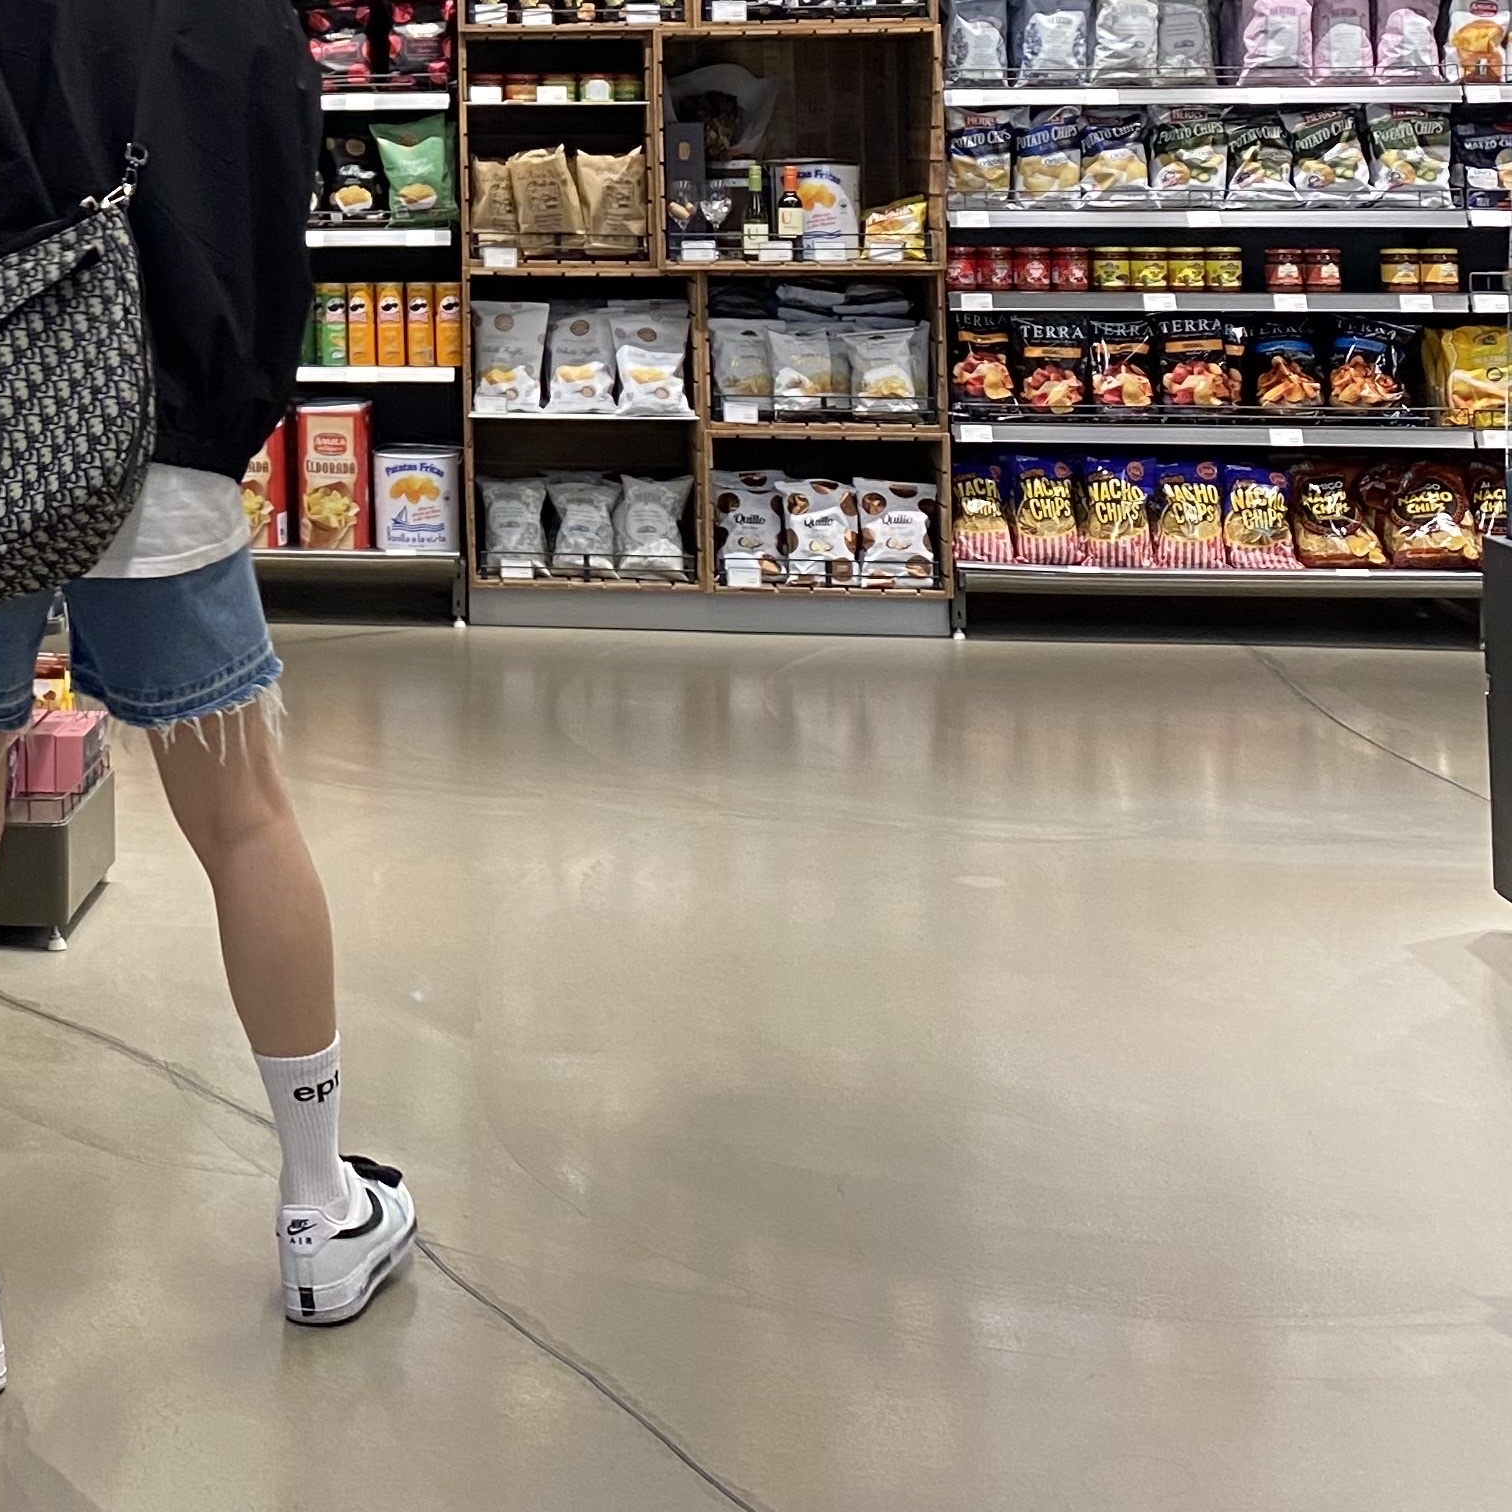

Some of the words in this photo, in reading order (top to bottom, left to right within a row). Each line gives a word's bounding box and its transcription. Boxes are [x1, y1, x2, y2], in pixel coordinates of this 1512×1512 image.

[1414, 119, 1445, 136] CHIPS
[1020, 324, 1084, 339] TERRA
[1159, 318, 1222, 333] TERRA
[305, 459, 357, 475] ELDORADA
[1089, 478, 1146, 503] NACHO
[1397, 490, 1454, 506] NACHO
[1029, 497, 1072, 520] CHIPS
[1094, 499, 1141, 524] CHIPS
[1406, 501, 1447, 514] CHIPS
[733, 513, 767, 527] Quillo
[802, 515, 834, 528] Quillo
[881, 513, 914, 527] Quillo
[1241, 507, 1285, 531] CHIPS
[289, 1236, 313, 1245] AIR
